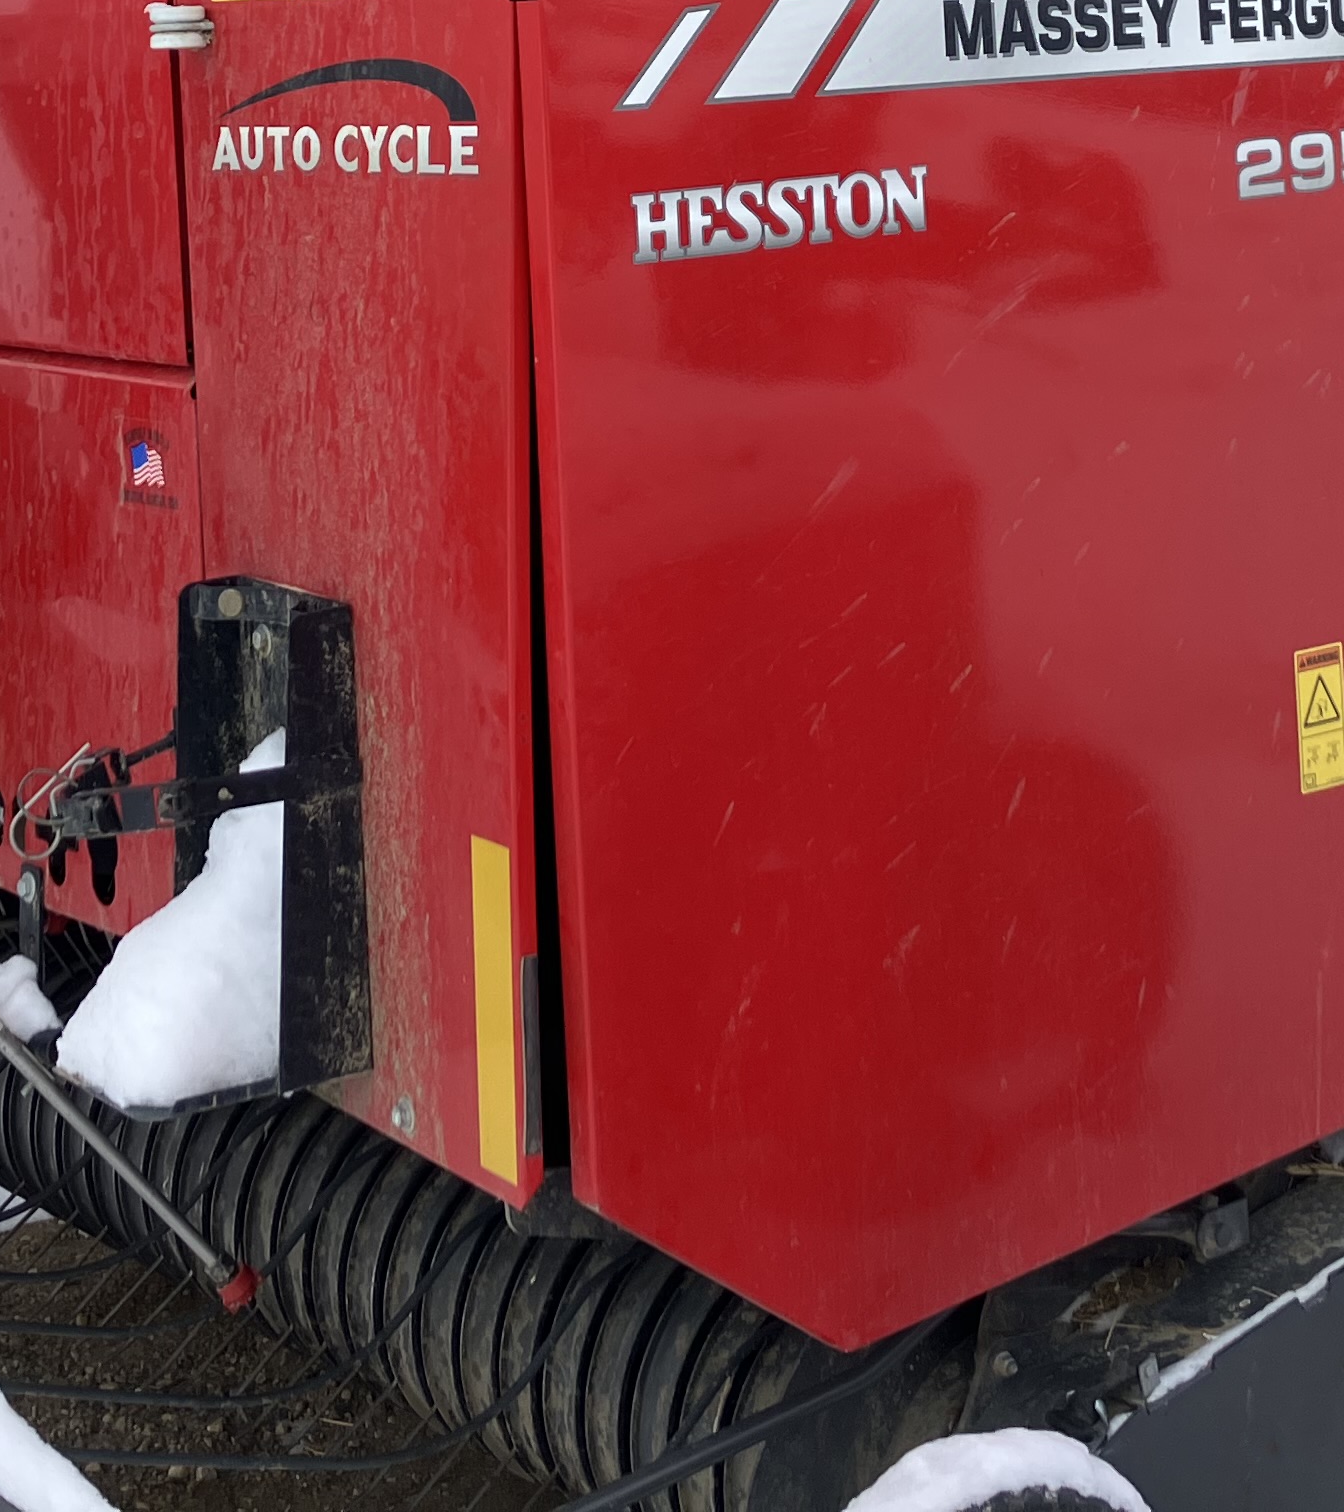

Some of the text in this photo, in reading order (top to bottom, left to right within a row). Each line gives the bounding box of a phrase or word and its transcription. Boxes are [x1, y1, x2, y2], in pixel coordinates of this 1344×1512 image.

[212, 124, 480, 175] AUTO CYCLE
[630, 164, 928, 266] HESSTON
